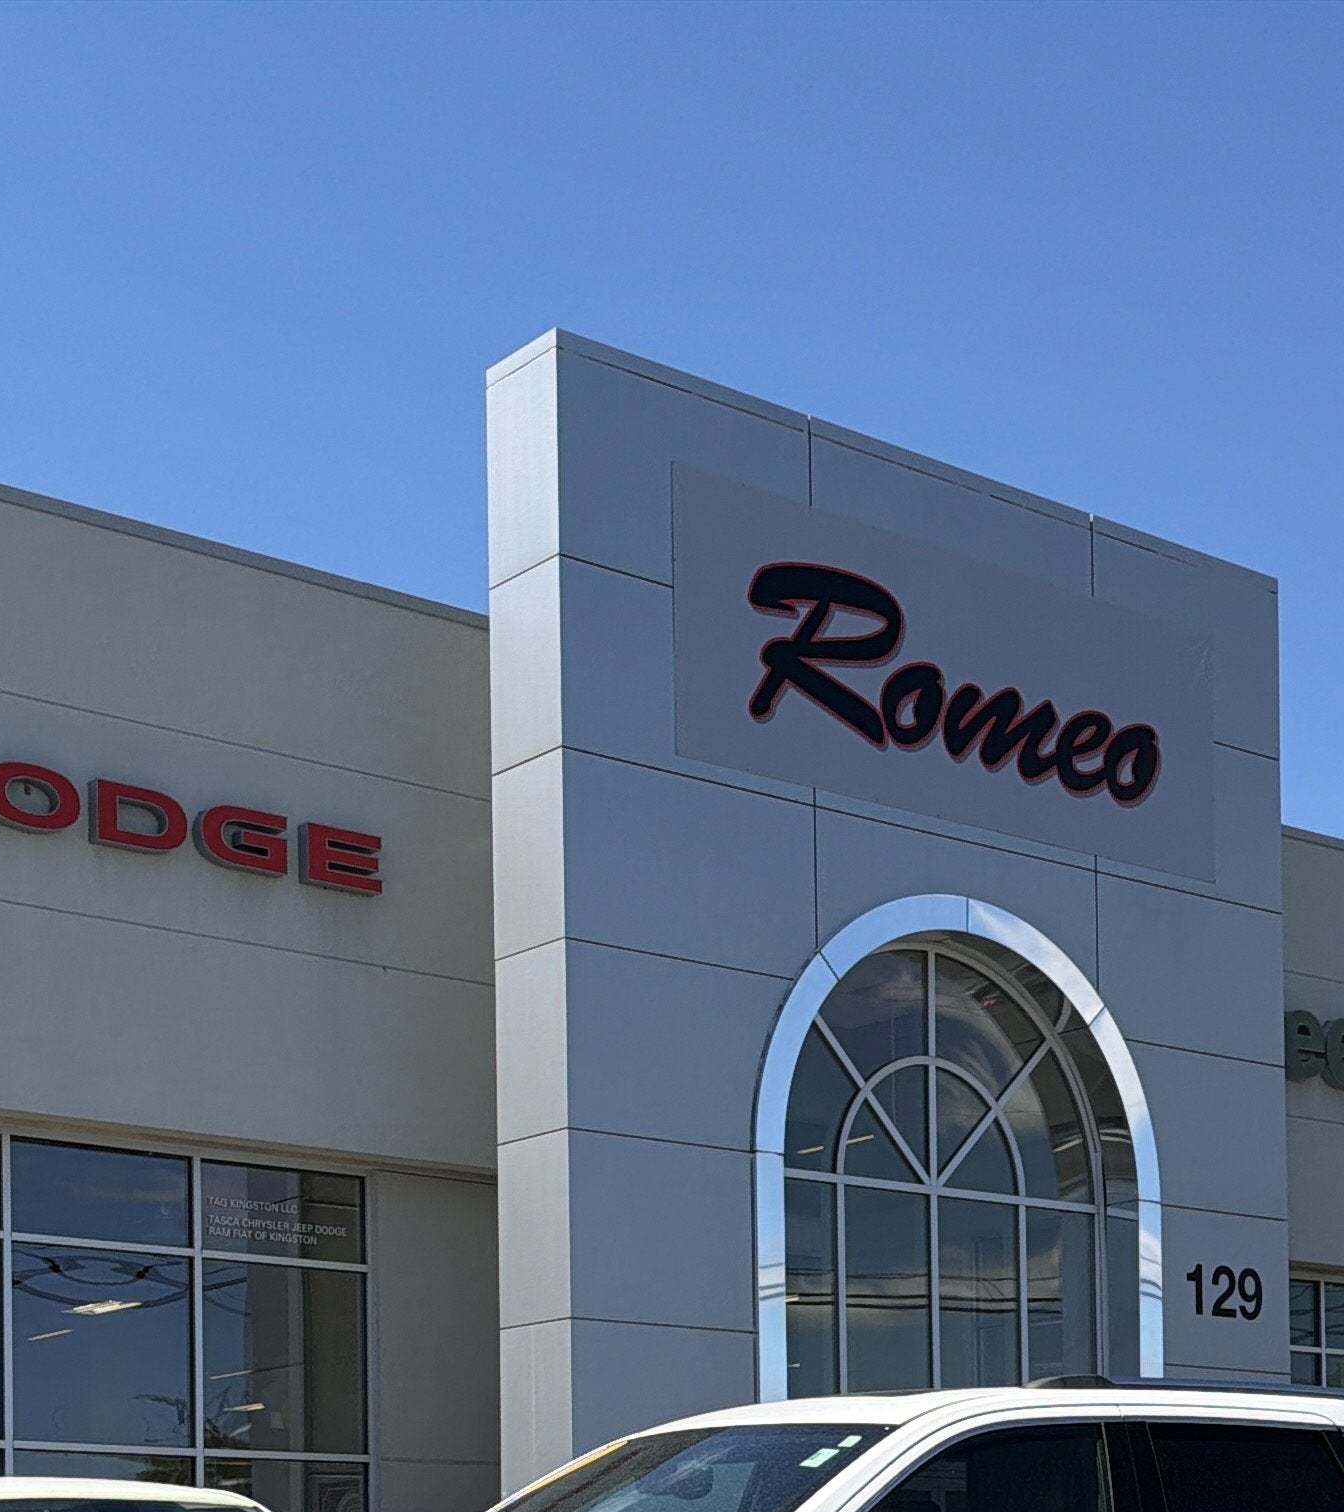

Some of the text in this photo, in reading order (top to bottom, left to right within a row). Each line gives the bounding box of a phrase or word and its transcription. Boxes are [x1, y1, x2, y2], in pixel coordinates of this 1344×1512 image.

[748, 561, 1161, 807] Romeo
[208, 1197, 298, 1214] TAG KINGSTON LLC
[208, 1215, 347, 1237] TASCA CHRYSLER JEEP DODGE
[208, 1227, 317, 1246] RAM FIAT OF KINGSTON
[1186, 1263, 1263, 1320] 129
